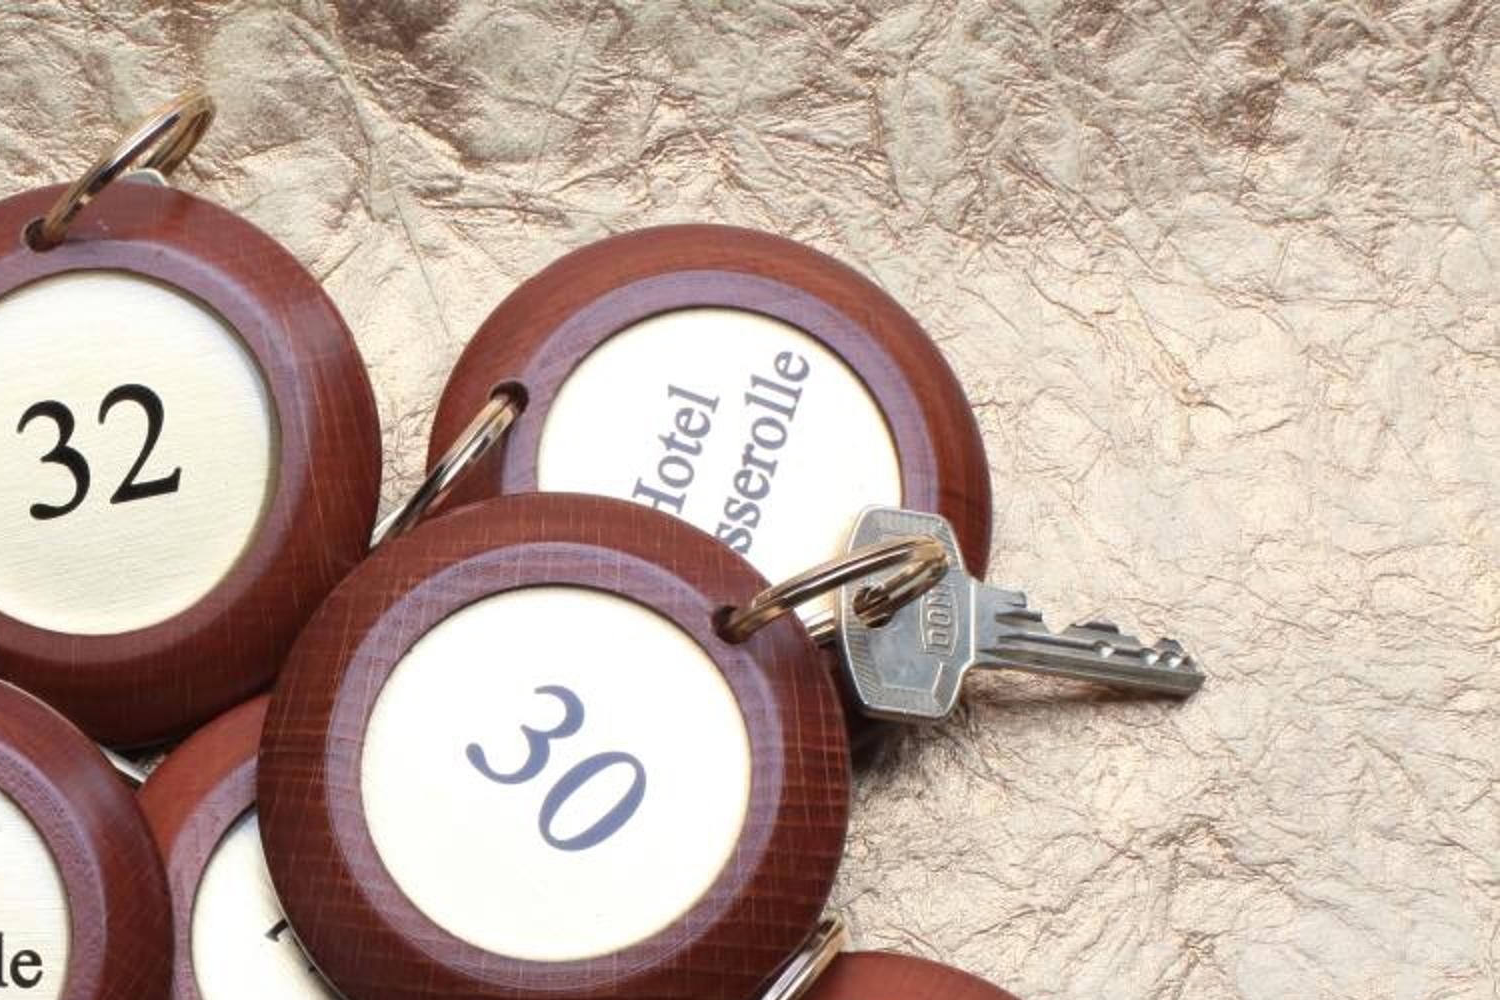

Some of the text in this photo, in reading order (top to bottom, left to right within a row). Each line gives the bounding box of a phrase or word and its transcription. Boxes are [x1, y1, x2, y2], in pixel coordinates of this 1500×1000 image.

[16, 384, 182, 520] 32
[713, 350, 811, 556] sserolle
[466, 684, 647, 851] 30
